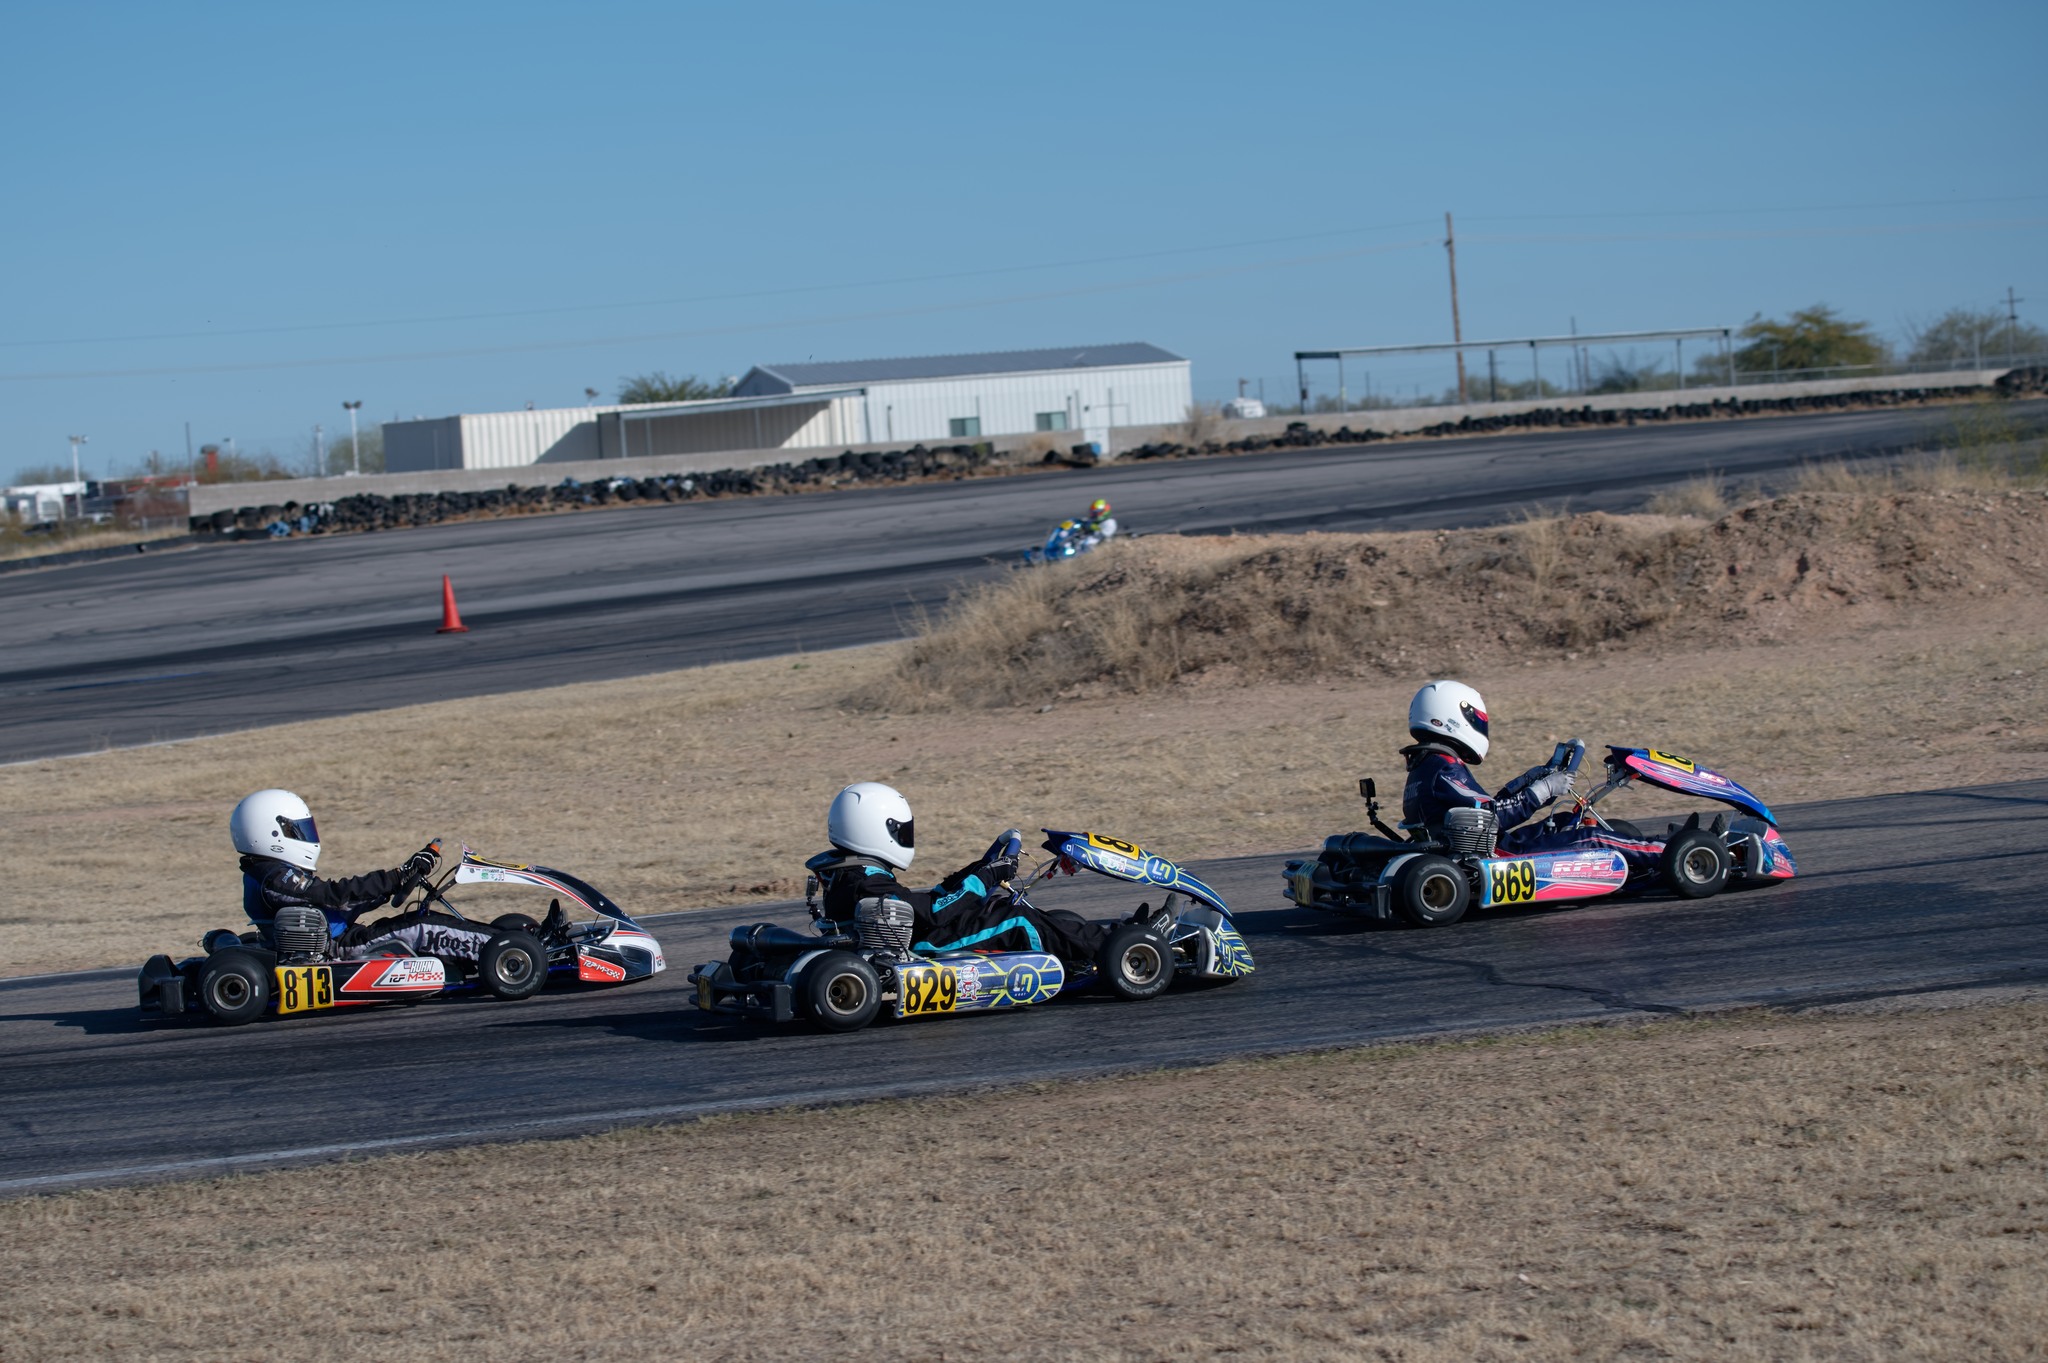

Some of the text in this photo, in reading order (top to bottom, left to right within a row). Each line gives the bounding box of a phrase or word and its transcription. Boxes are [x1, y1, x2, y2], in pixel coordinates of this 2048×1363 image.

[1491, 861, 1534, 903] 869
[284, 968, 331, 1009] 813
[905, 968, 956, 1013] 829
